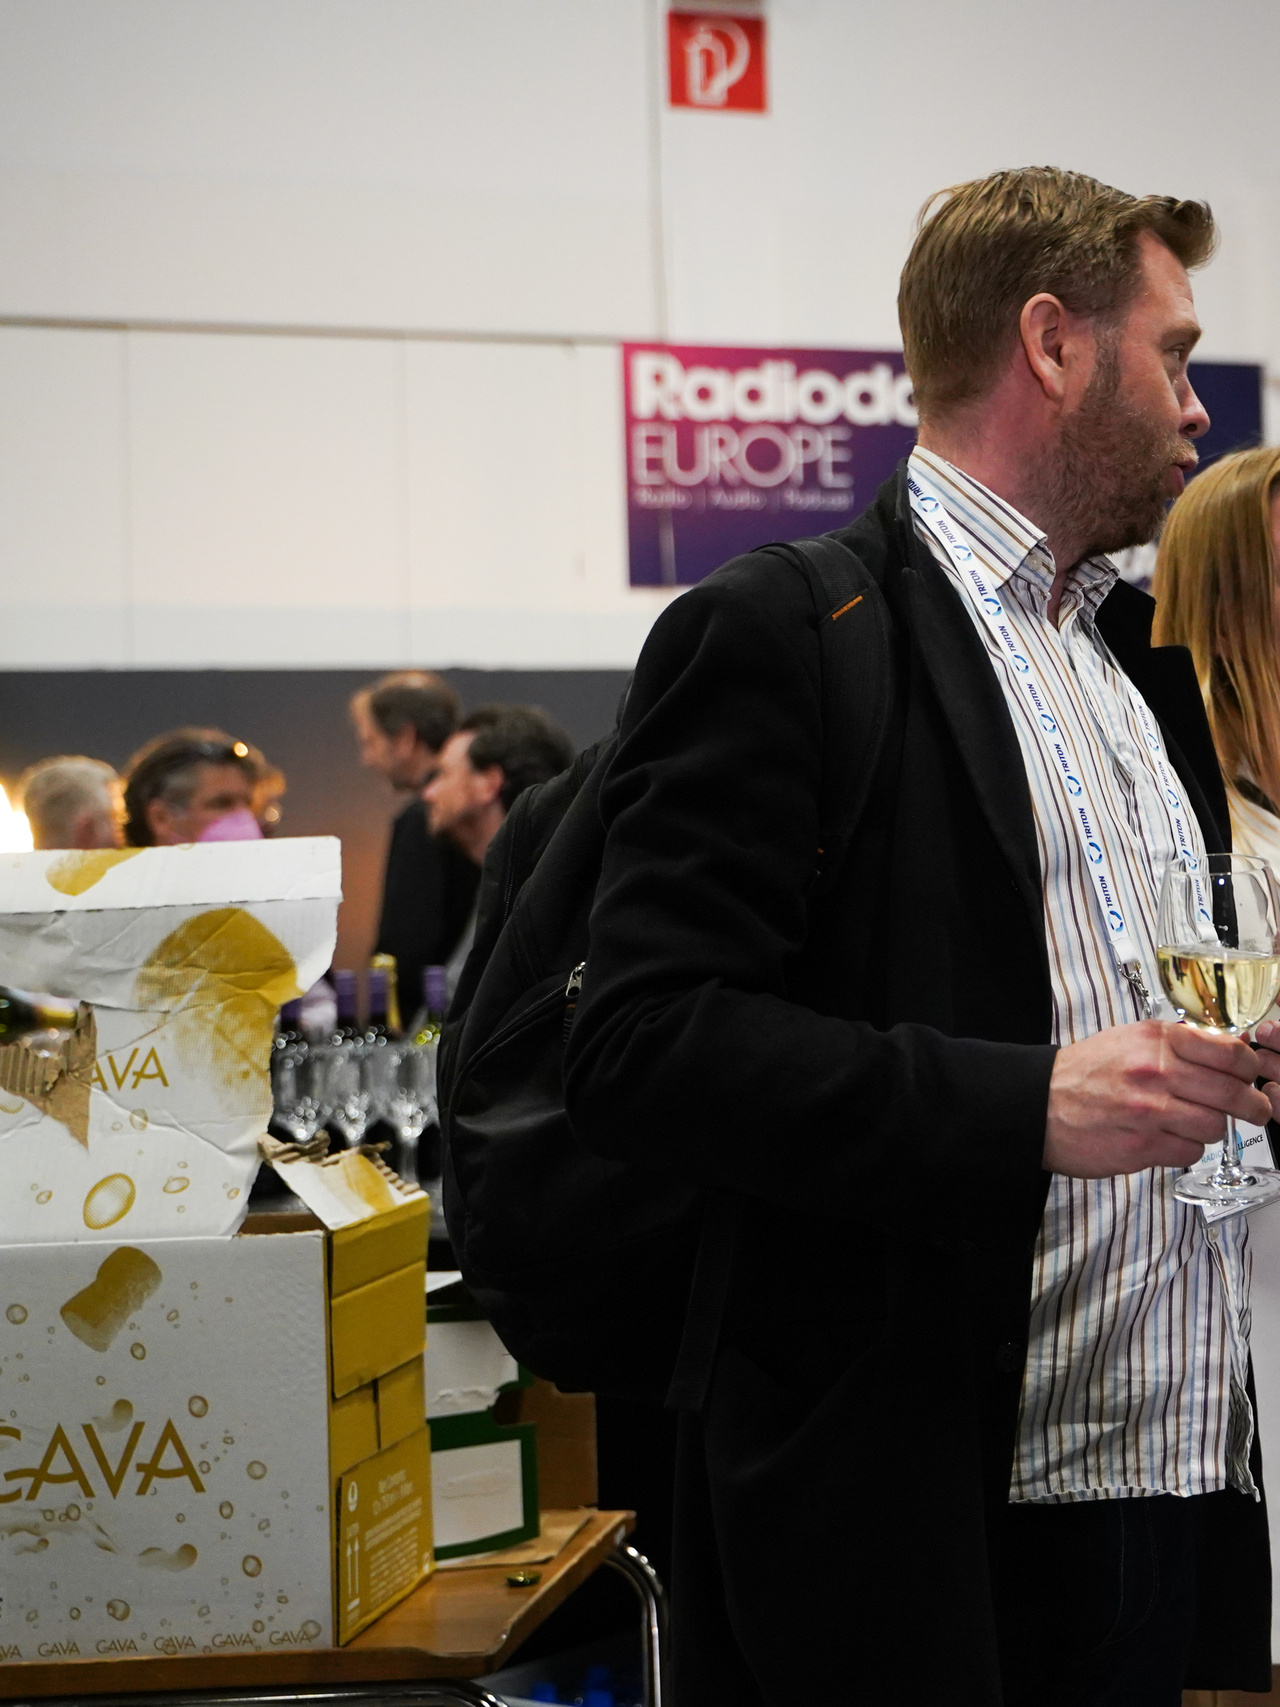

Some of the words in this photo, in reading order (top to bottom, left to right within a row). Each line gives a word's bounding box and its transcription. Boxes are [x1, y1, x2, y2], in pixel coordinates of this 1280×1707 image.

[631, 422, 852, 488] EUROPE
[936, 520, 956, 543] TRITON
[968, 569, 989, 597] TRITON
[998, 625, 1016, 652] TRITON
[1027, 683, 1044, 711] TRITON
[1053, 743, 1071, 773] TRITON
[1078, 807, 1094, 840] TRITON
[1175, 818, 1187, 847] TRITON
[1098, 875, 1114, 908] TRITON
[1195, 879, 1204, 907] TRITON
[37, 1642, 81, 1657] CAVA
[96, 1639, 138, 1654] CAVA
[154, 1636, 197, 1651] CAVA
[211, 1633, 253, 1649] CAVA
[269, 1630, 311, 1645] CAVA
